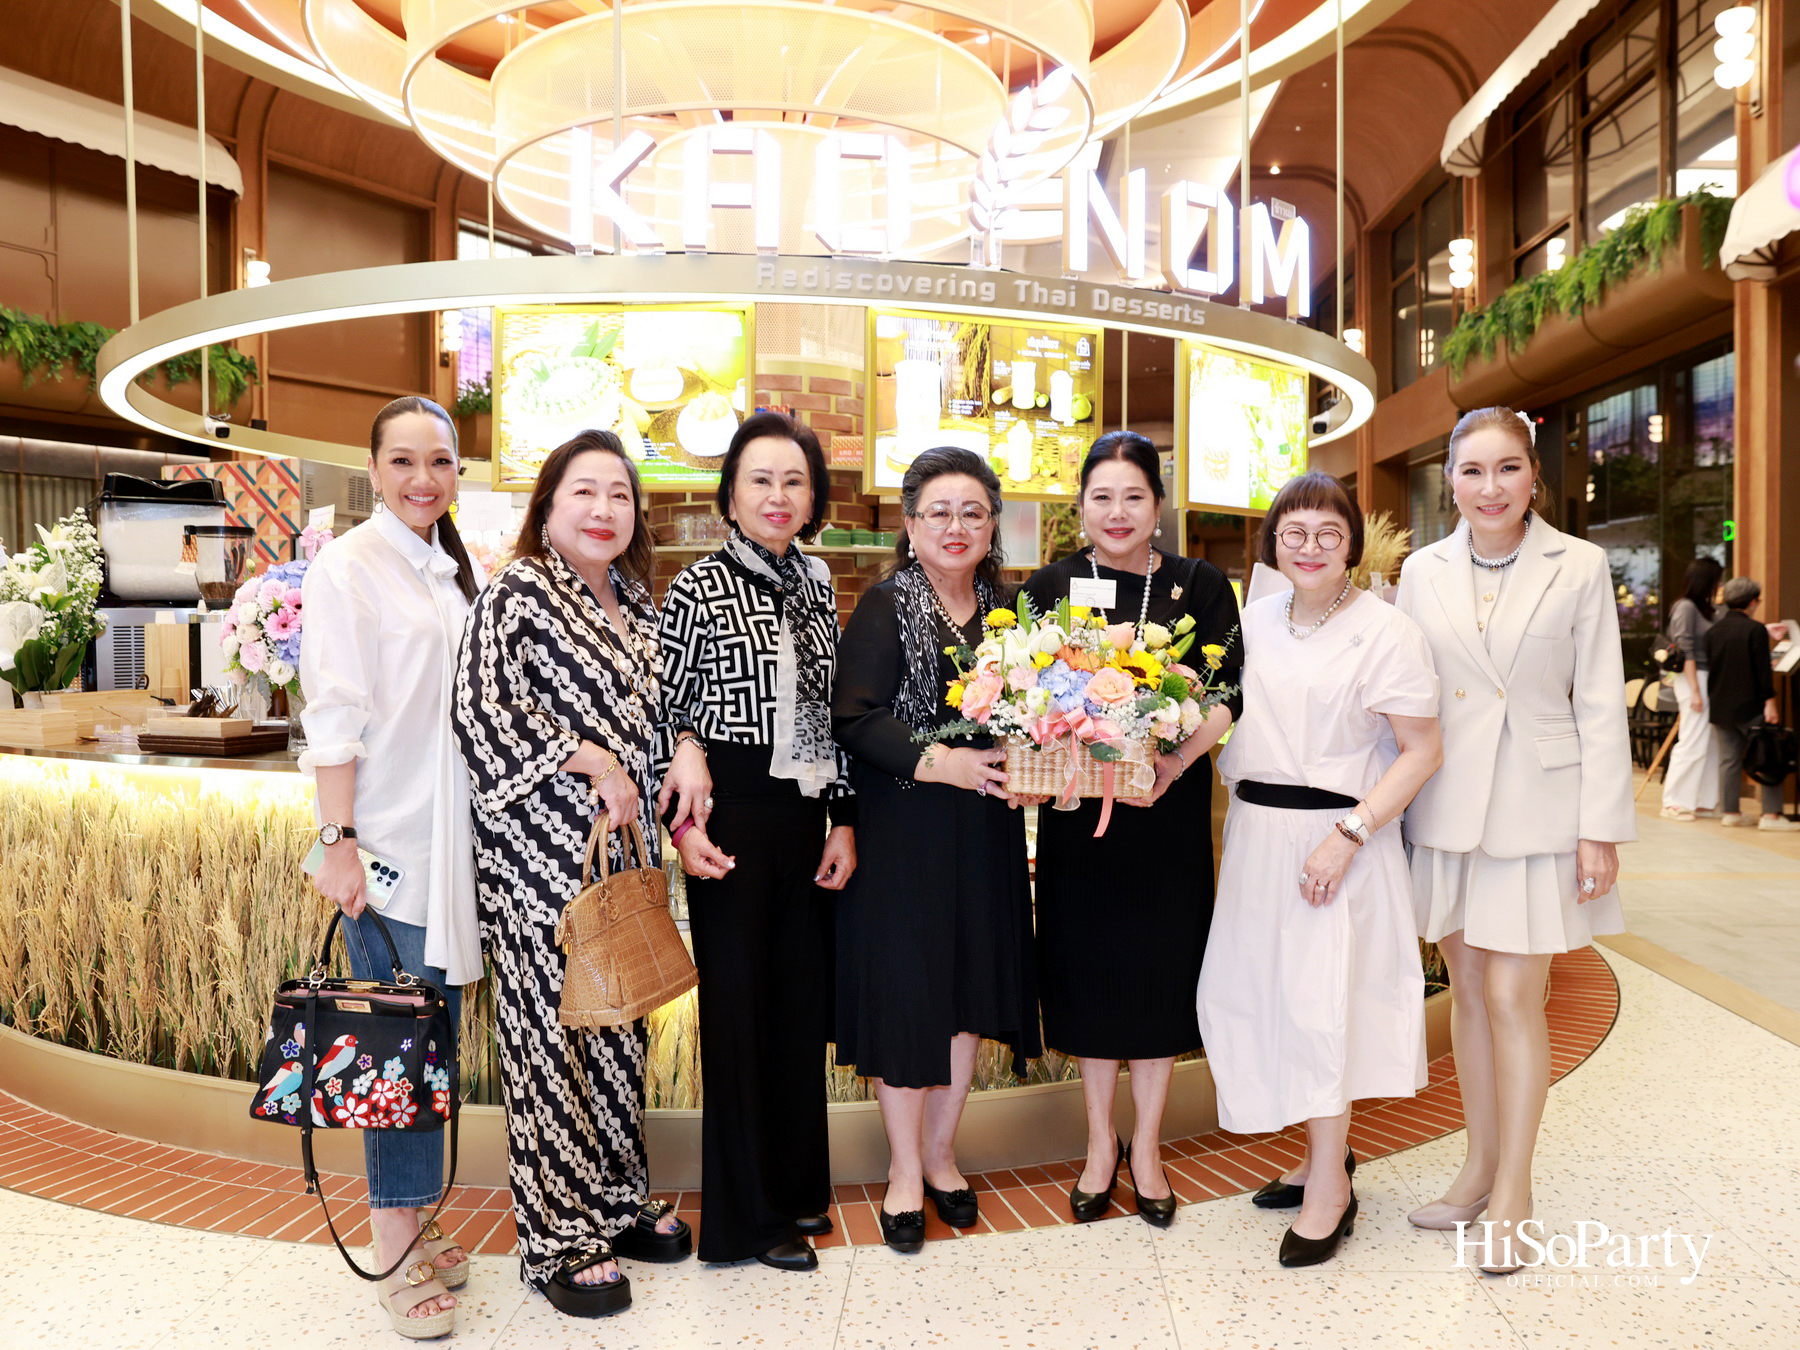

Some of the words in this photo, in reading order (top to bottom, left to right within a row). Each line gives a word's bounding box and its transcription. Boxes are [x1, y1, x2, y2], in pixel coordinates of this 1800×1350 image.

[570, 126, 912, 254] KAO
[1063, 163, 1311, 318] NOM
[757, 262, 997, 303] Rediscovering
[1014, 279, 1076, 308] Thai
[1093, 288, 1206, 326] Desserts
